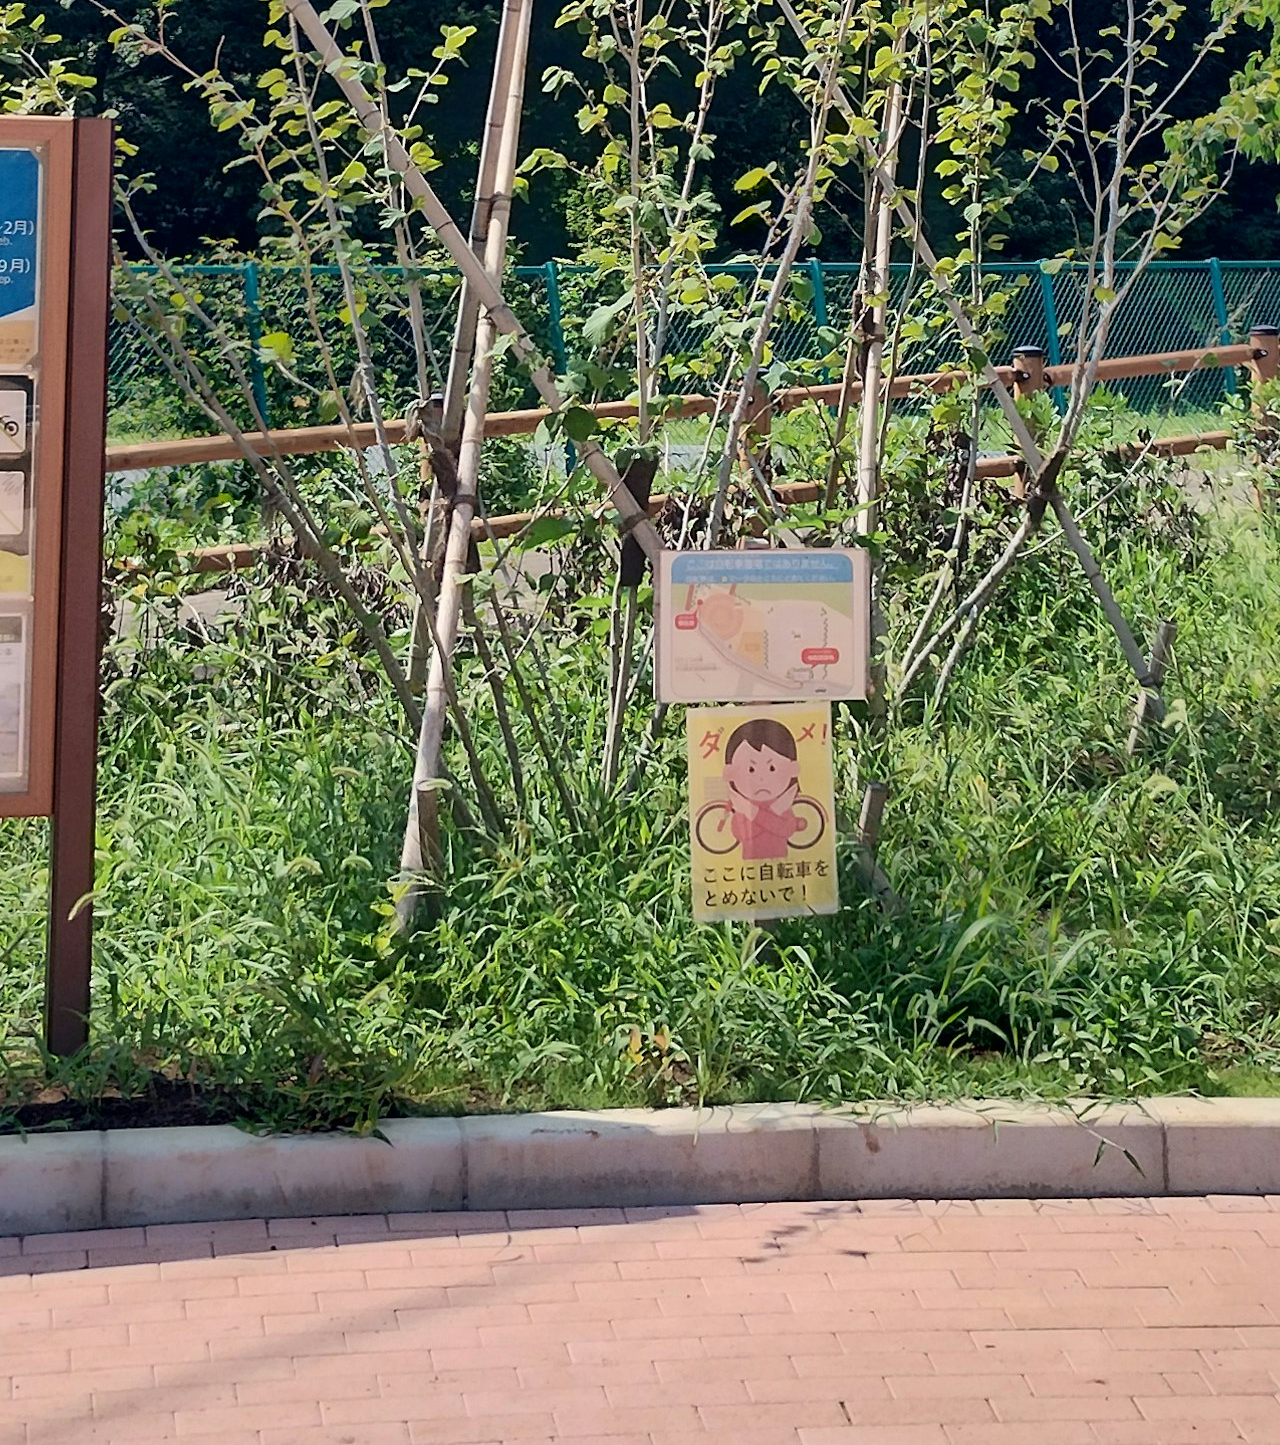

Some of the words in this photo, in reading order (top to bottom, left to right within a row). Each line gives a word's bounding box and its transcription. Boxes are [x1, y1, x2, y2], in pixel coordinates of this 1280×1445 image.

[699, 726, 725, 760] ダ
[704, 859, 830, 883] ここに自転車を
[705, 884, 808, 907] とめないで！
